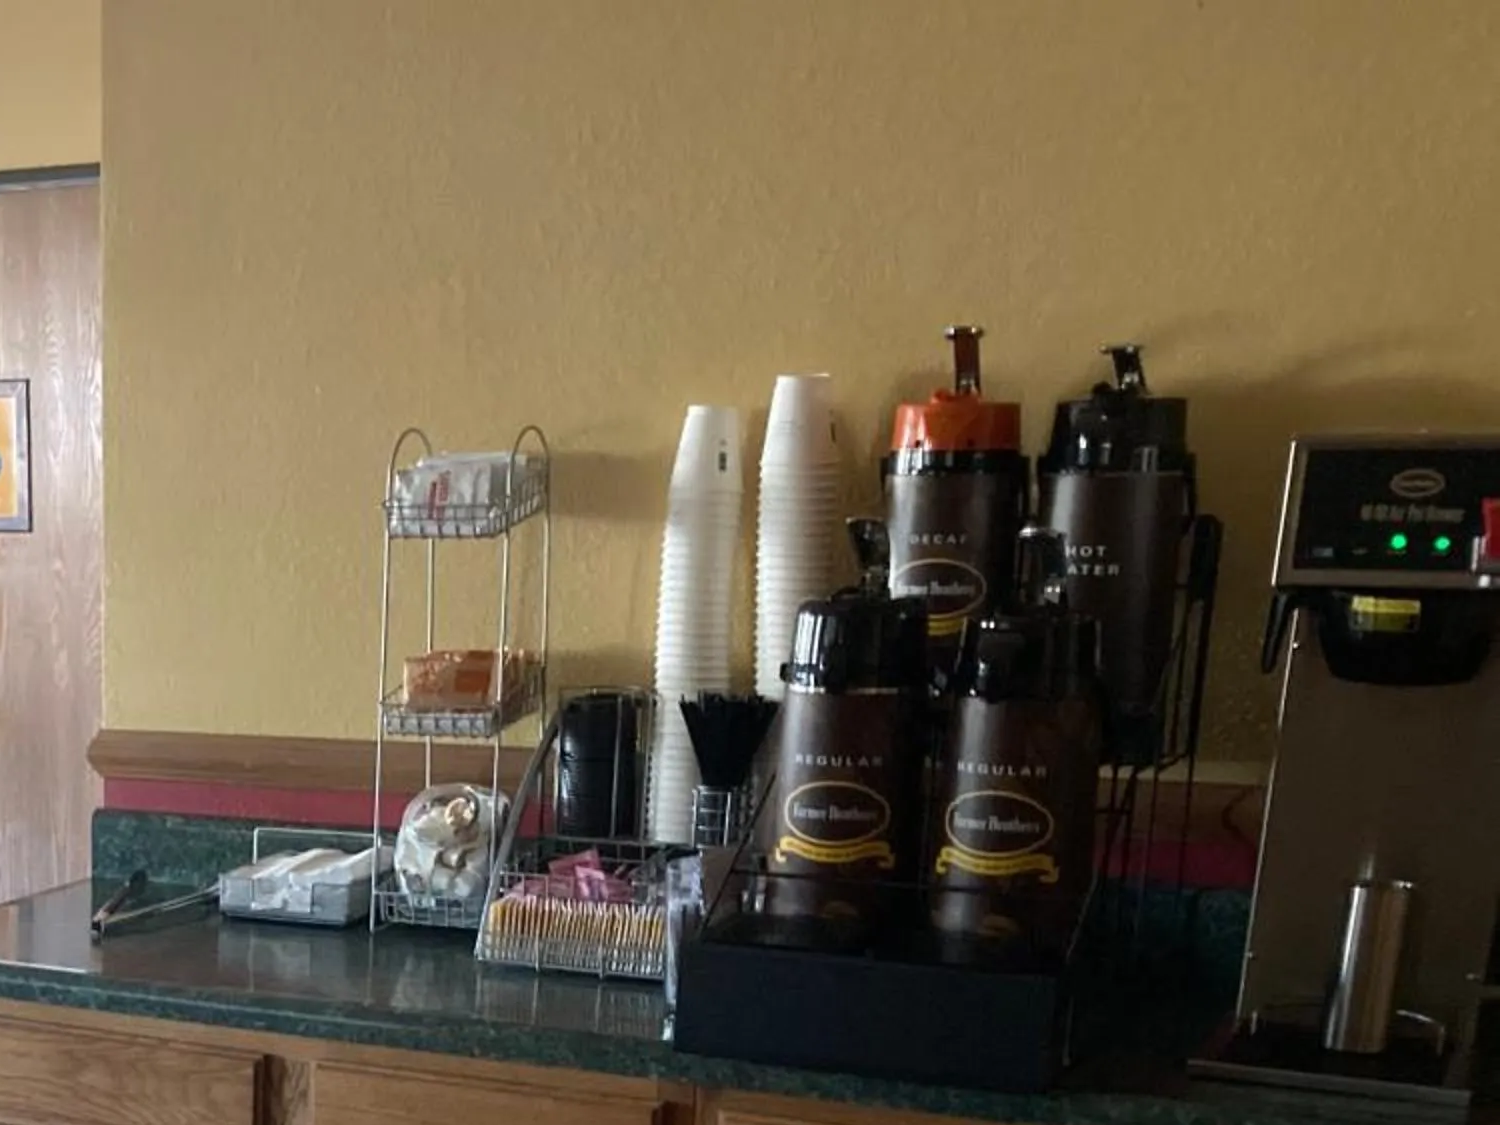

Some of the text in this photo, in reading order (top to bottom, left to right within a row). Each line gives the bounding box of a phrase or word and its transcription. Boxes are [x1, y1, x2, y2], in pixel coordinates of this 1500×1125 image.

[909, 533, 967, 545] DECAF
[1065, 545, 1106, 558] HOT
[1066, 564, 1120, 577] ATER
[795, 754, 882, 768] REGULAR
[957, 761, 1047, 777] REGULAR
